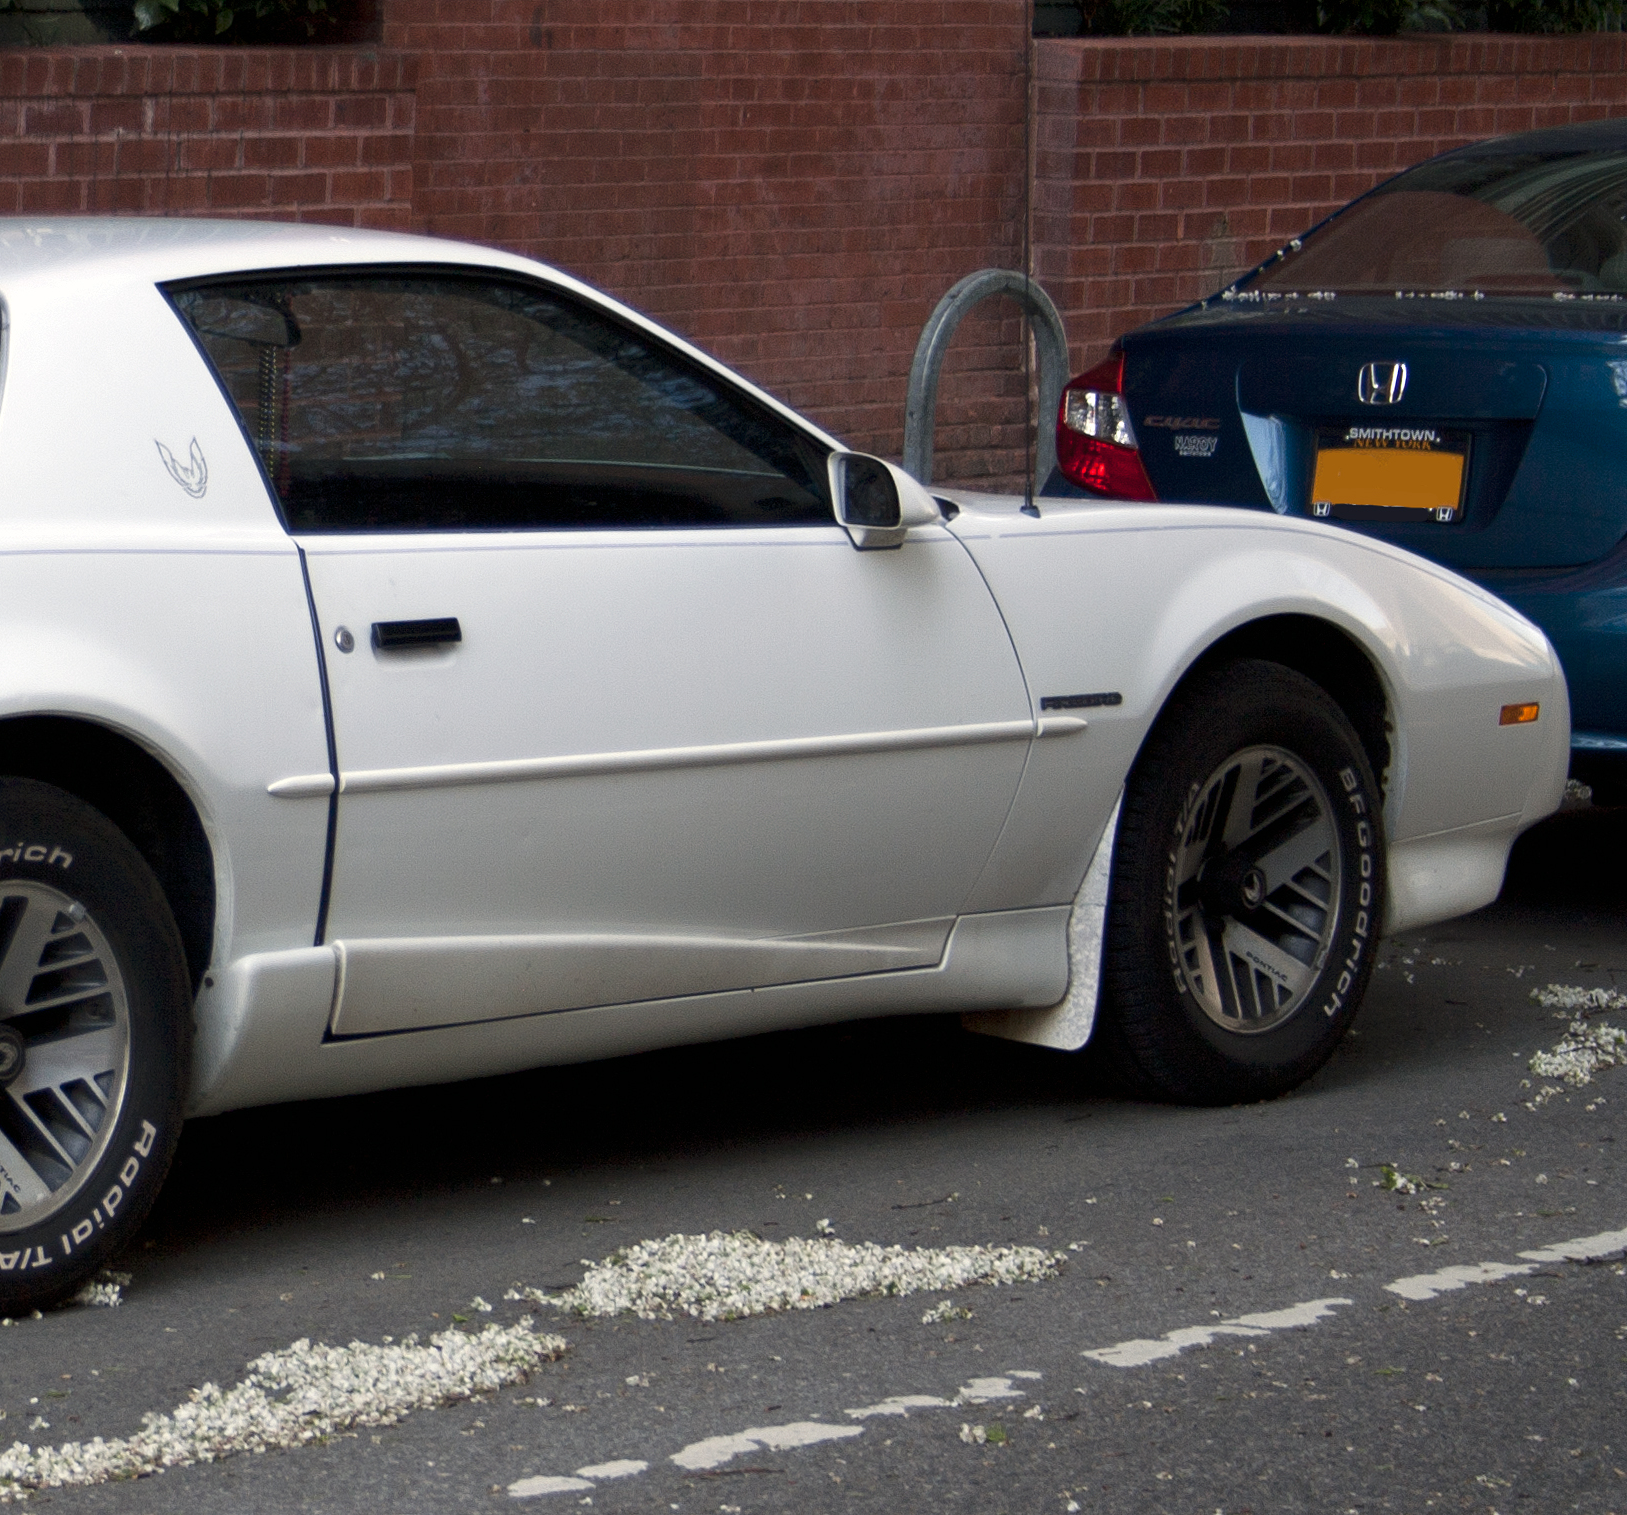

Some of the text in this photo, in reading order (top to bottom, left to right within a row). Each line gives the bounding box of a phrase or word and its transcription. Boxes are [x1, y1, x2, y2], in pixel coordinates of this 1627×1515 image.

[1349, 427, 1436, 442] SMITHTOWN
[1323, 767, 1372, 1018] BFGoodrich
[61, 1119, 158, 1257] Radial
